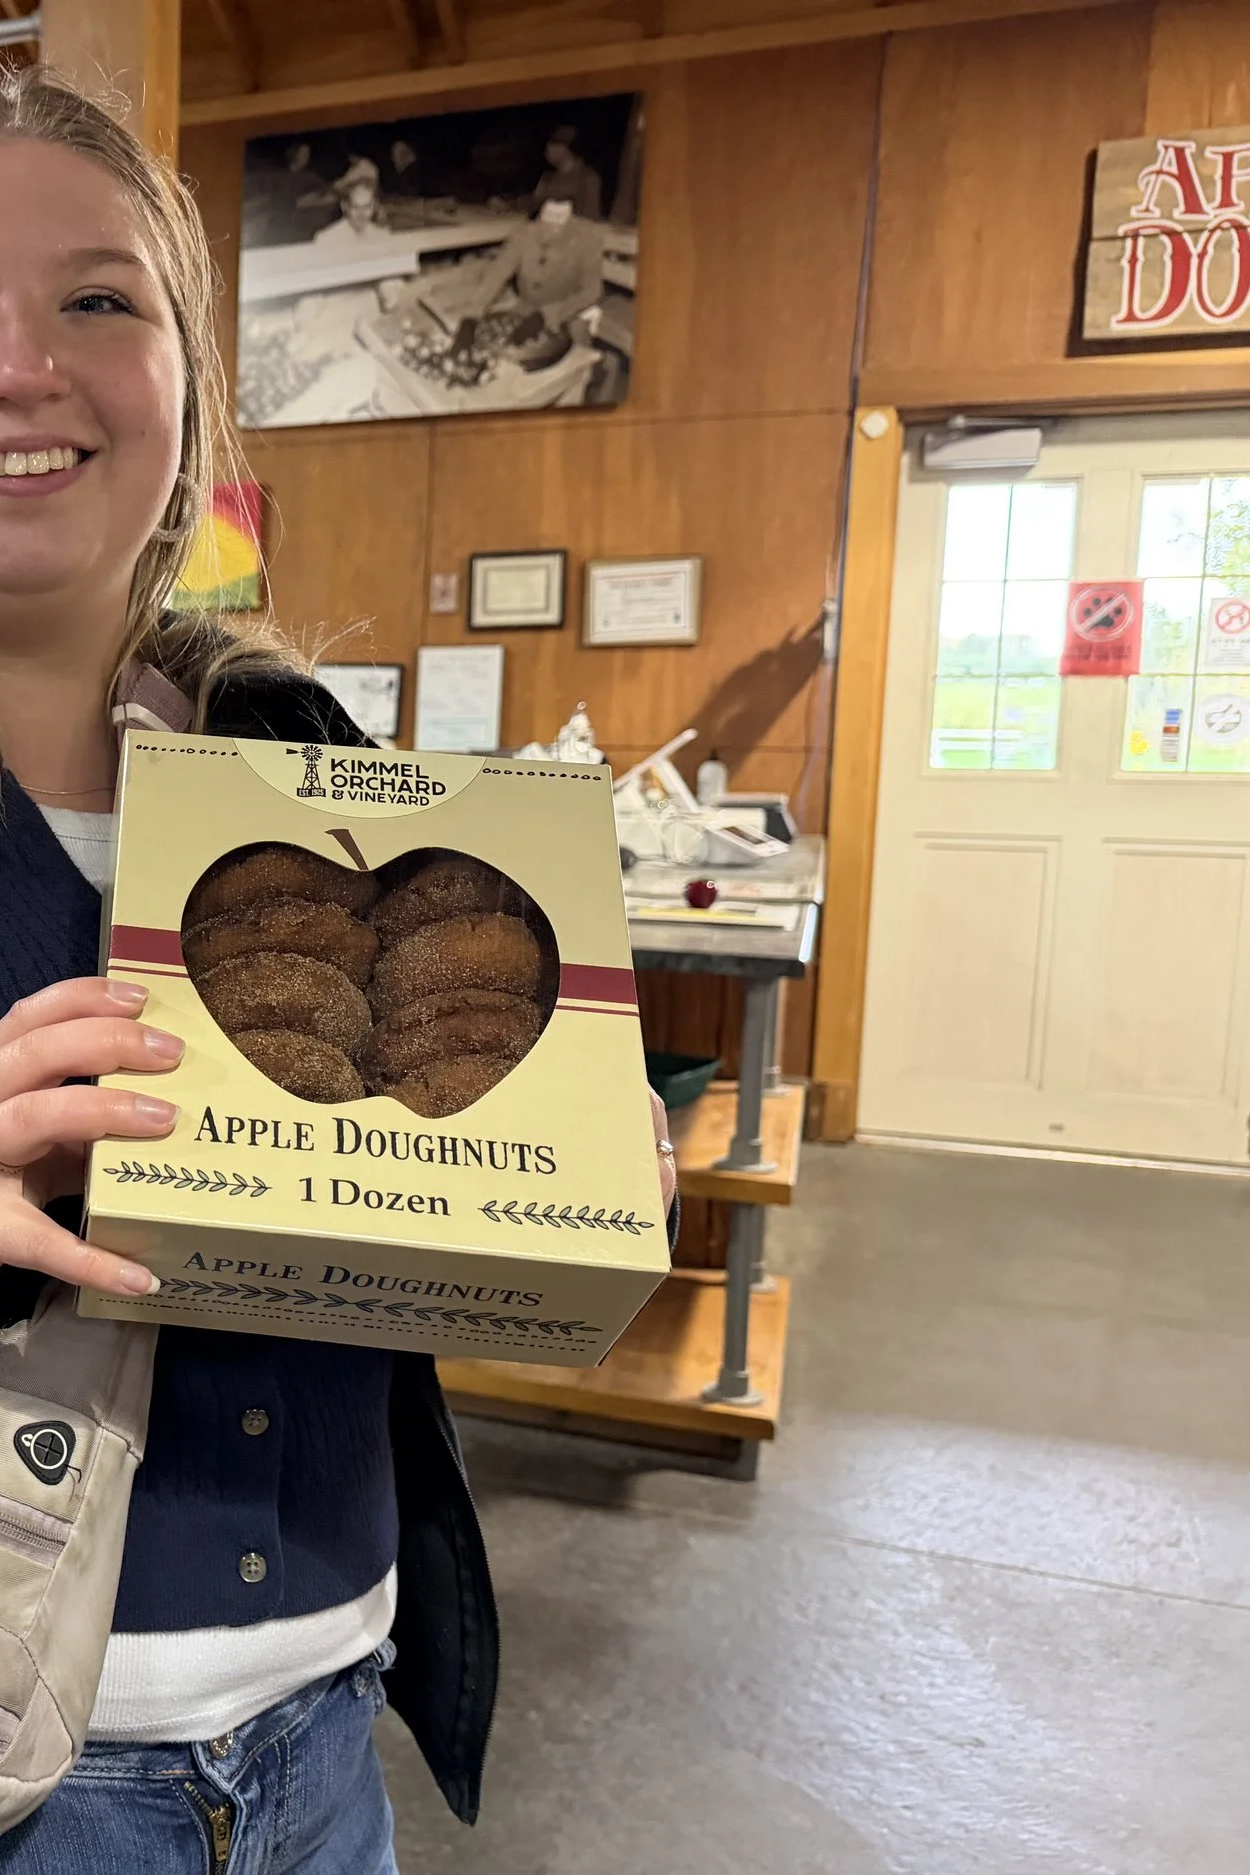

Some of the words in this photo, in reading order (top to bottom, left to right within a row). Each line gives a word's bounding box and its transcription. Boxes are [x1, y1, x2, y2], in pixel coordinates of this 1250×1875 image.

[1110, 213, 1250, 330] DO
[330, 758, 430, 780] KIMMEL
[330, 774, 447, 796] ORCHARD
[331, 789, 344, 800] &
[347, 791, 430, 807] VINEYARD
[194, 1106, 315, 1152] APPLE
[332, 1117, 557, 1176] DOUGHNUTS
[298, 1177, 317, 1203] 1
[330, 1178, 452, 1217] Dozen
[182, 1252, 303, 1281] APPLE
[319, 1264, 544, 1307] DOUGHNUTS
